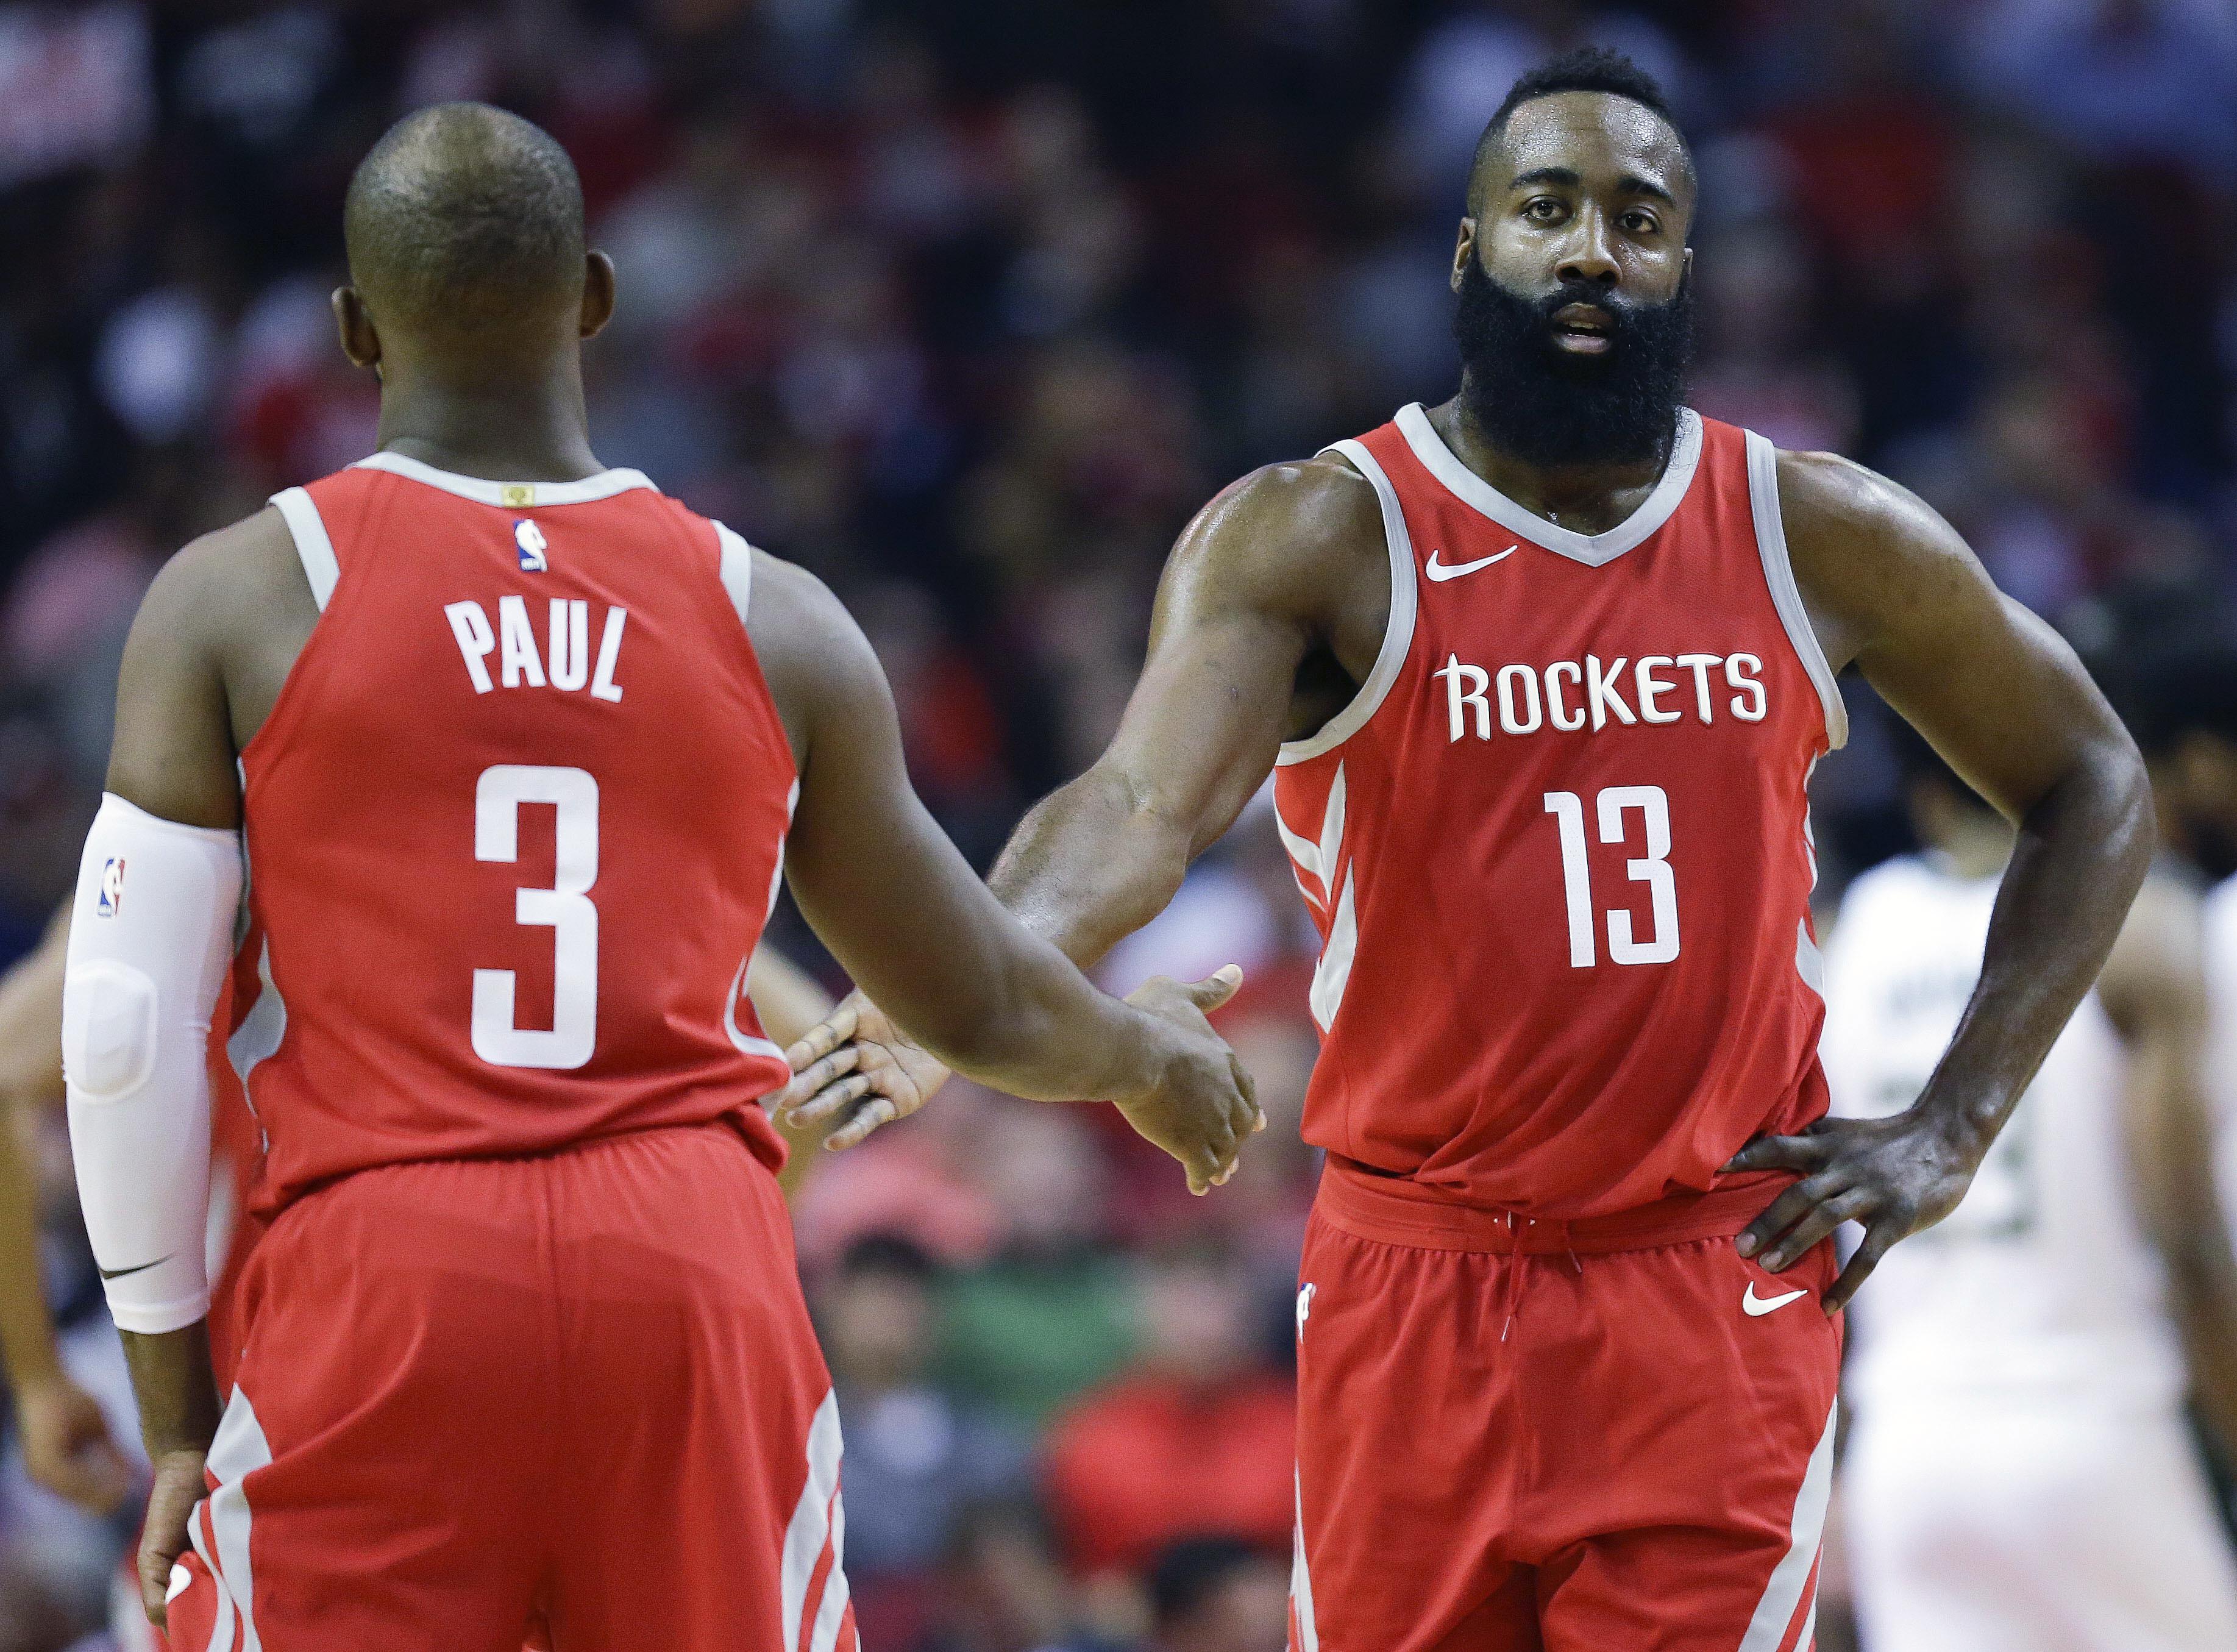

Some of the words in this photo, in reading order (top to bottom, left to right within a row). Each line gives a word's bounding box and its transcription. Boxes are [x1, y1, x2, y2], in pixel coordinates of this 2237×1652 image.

[444, 595, 628, 703] PAUL
[1434, 652, 1768, 744] ROCKETS
[471, 764, 600, 1069] 3
[1543, 785, 1681, 968] 13
